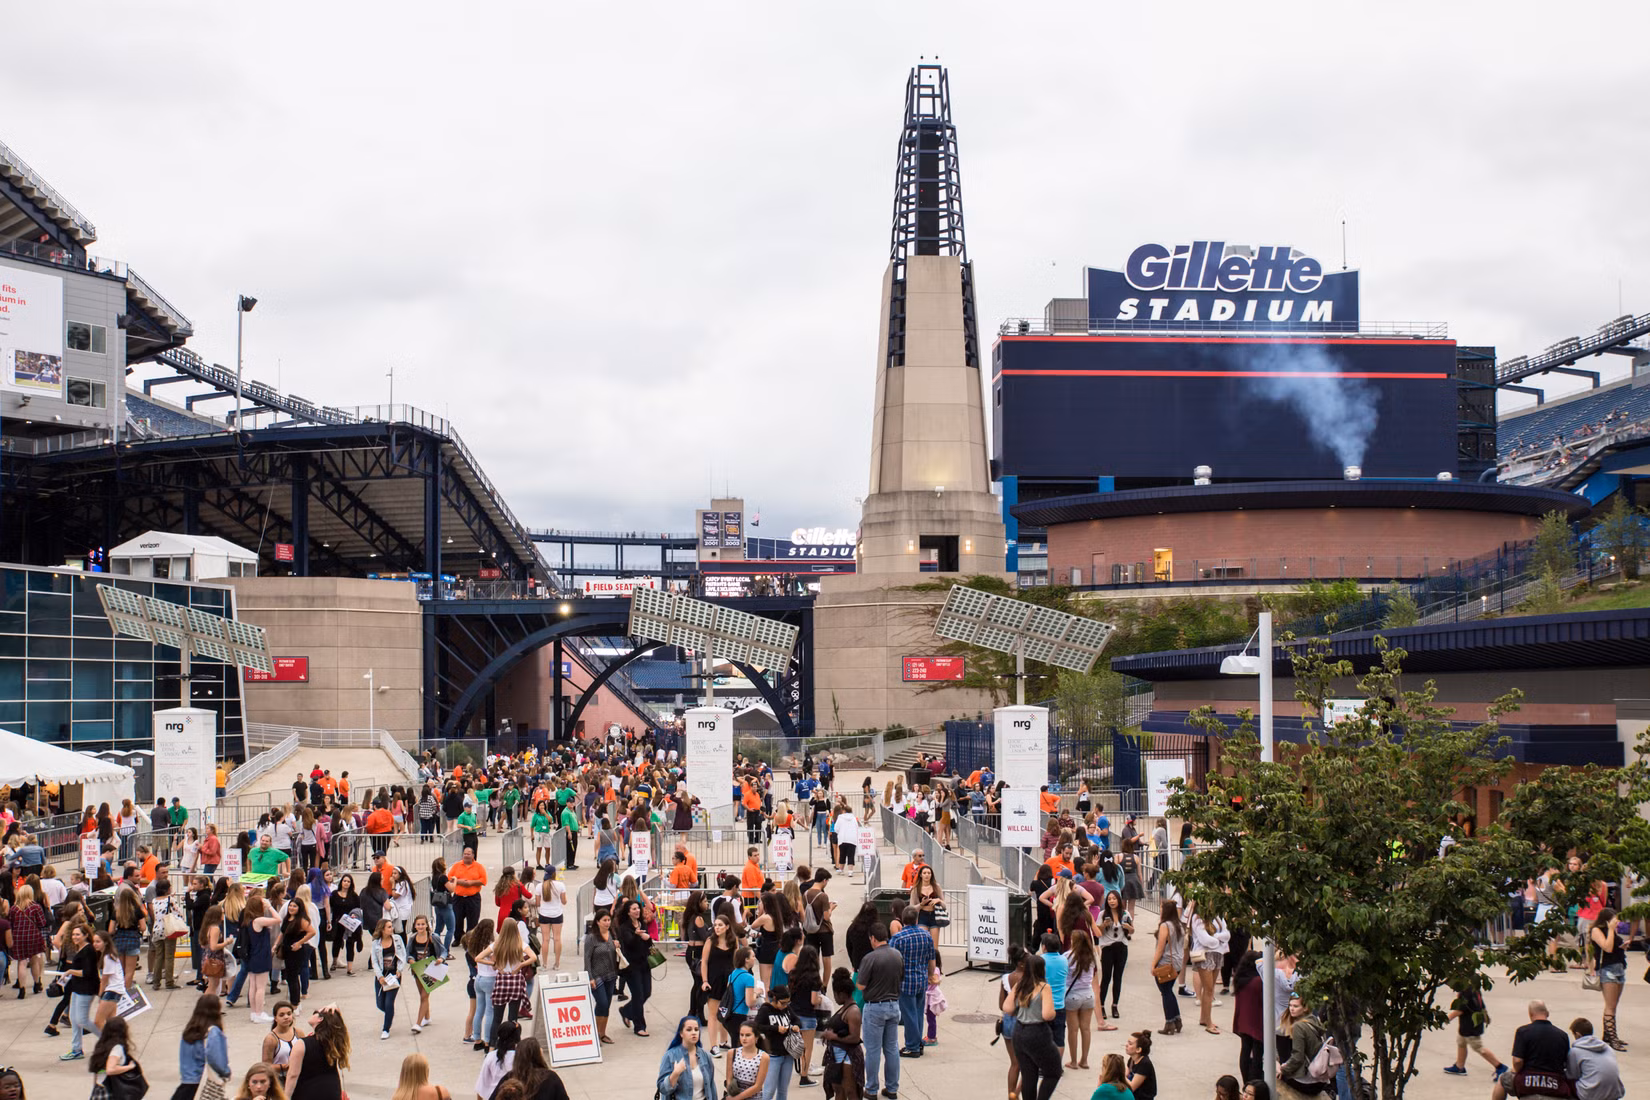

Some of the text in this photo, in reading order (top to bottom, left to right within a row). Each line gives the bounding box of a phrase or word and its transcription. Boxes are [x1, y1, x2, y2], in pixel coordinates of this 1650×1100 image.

[1125, 241, 1323, 293] Gillette
[2, 284, 16, 294] fits
[18, 296, 26, 306] in
[1117, 298, 1333, 322] STADIUM
[791, 527, 856, 546] Gillette
[166, 723, 184, 733] nrg
[698, 721, 715, 731] nrg
[1014, 720, 1030, 730] nrg
[978, 915, 998, 923] WILL
[978, 926, 998, 935] CALL
[973, 936, 1004, 945] WINDOWS
[557, 1006, 581, 1023] NO
[552, 1024, 591, 1038] RE-ENTRY
[1525, 1075, 1558, 1089] UMASS
